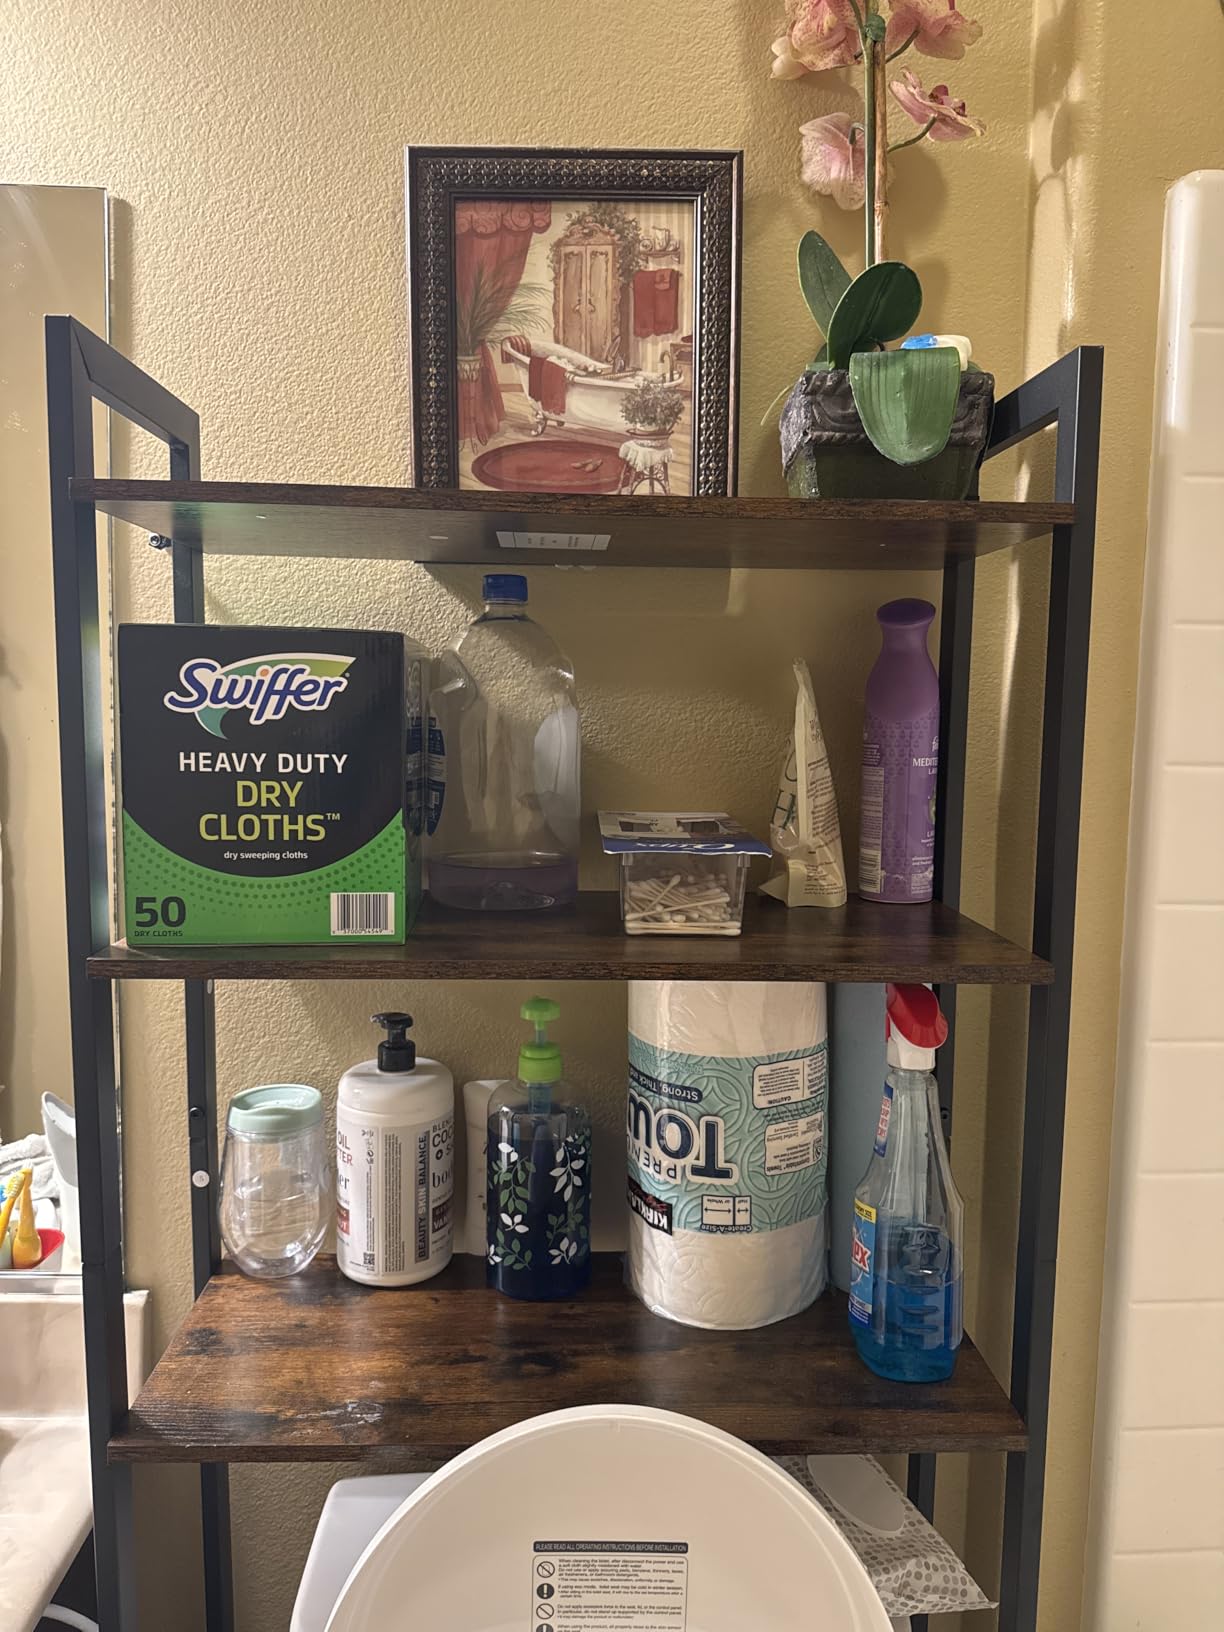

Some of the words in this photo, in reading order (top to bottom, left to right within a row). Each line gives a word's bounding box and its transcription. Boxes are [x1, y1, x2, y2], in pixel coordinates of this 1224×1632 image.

[165, 659, 346, 723] Swiffer
[179, 752, 266, 772] HEAVY
[278, 754, 348, 773] DUTY
[236, 781, 303, 807] DRY
[224, 851, 238, 860] dry
[240, 851, 280, 860] sweeping
[282, 851, 308, 860] cloths
[135, 896, 186, 928] 50
[656, 1080, 698, 1101] Strong,
[337, 1149, 353, 1166] TER
[418, 1137, 428, 1185] BALANCE
[418, 1188, 428, 1214] SKIN
[419, 1217, 428, 1257] BEAUTY
[701, 1225, 752, 1233] Create-A-Size
